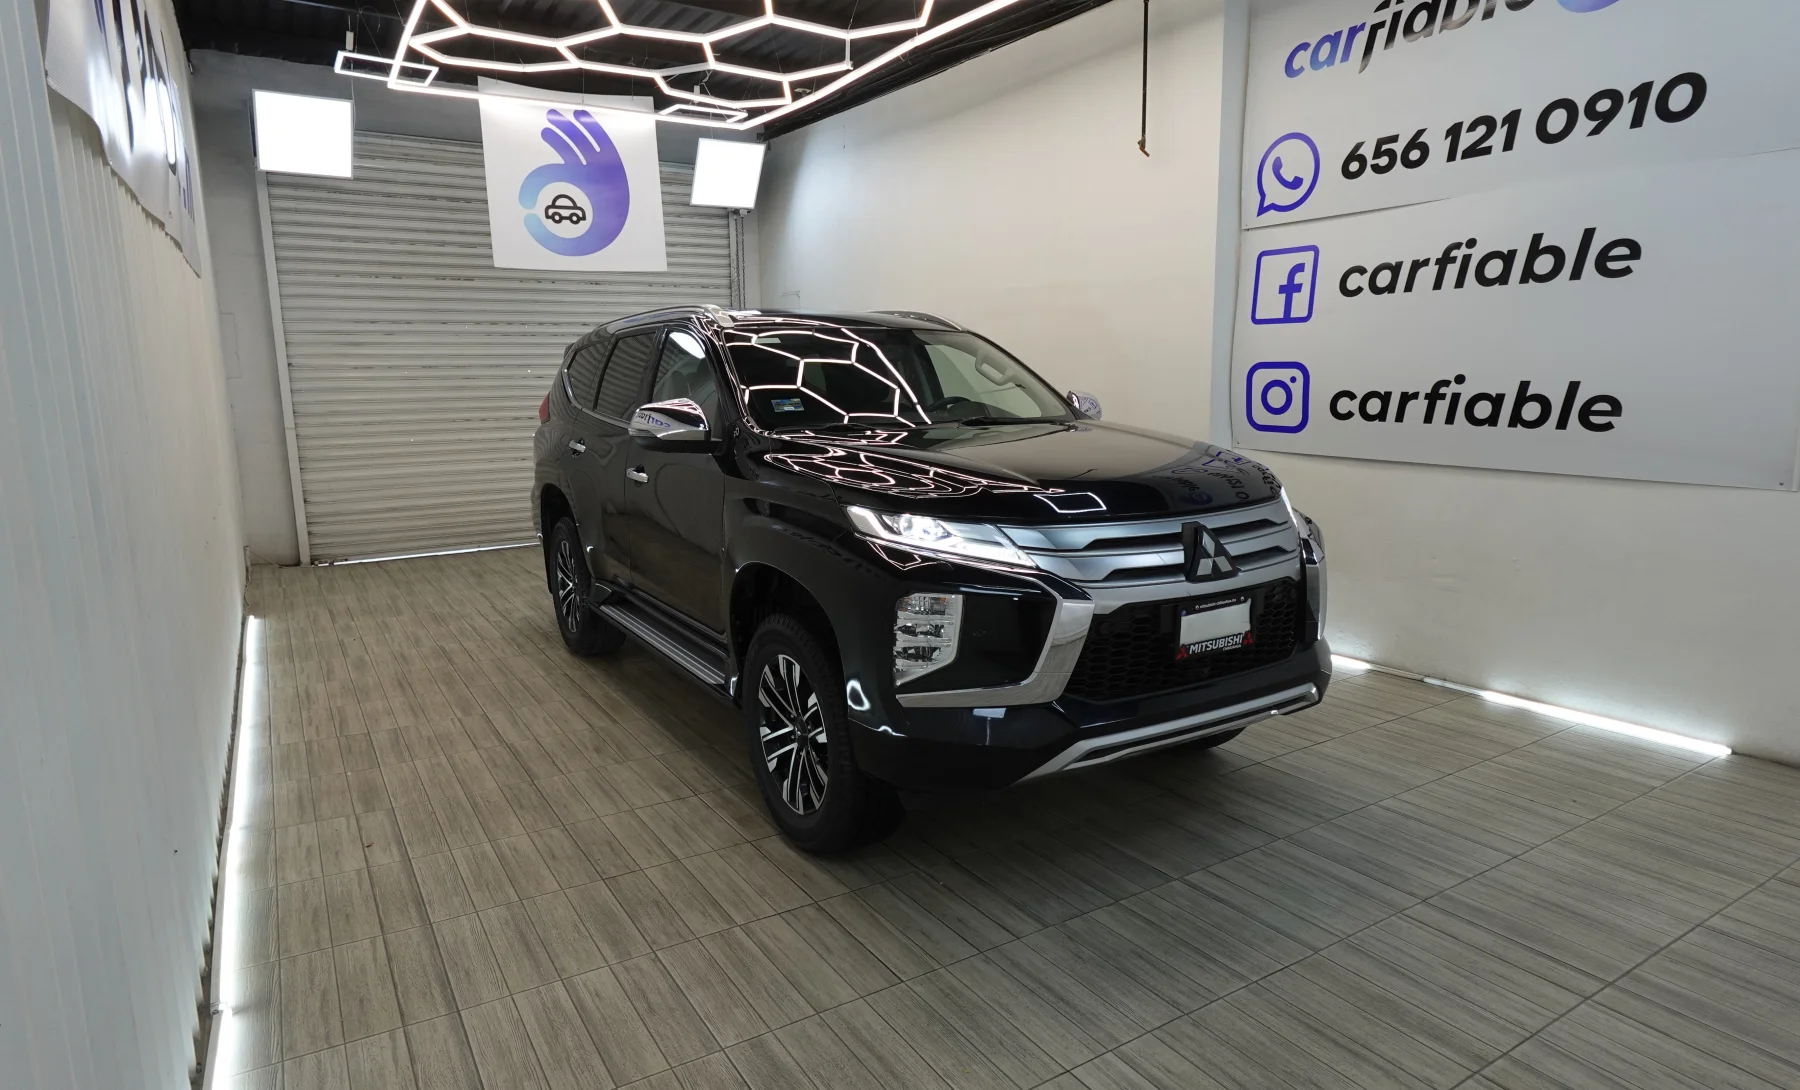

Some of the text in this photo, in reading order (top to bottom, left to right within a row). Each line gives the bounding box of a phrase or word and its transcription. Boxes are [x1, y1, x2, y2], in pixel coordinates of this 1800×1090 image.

[1340, 72, 1708, 180] 656 121 0910
[1338, 227, 1642, 298] carfiable
[1329, 374, 1623, 433] carfiable
[1189, 634, 1243, 655] MITSUBISHI
